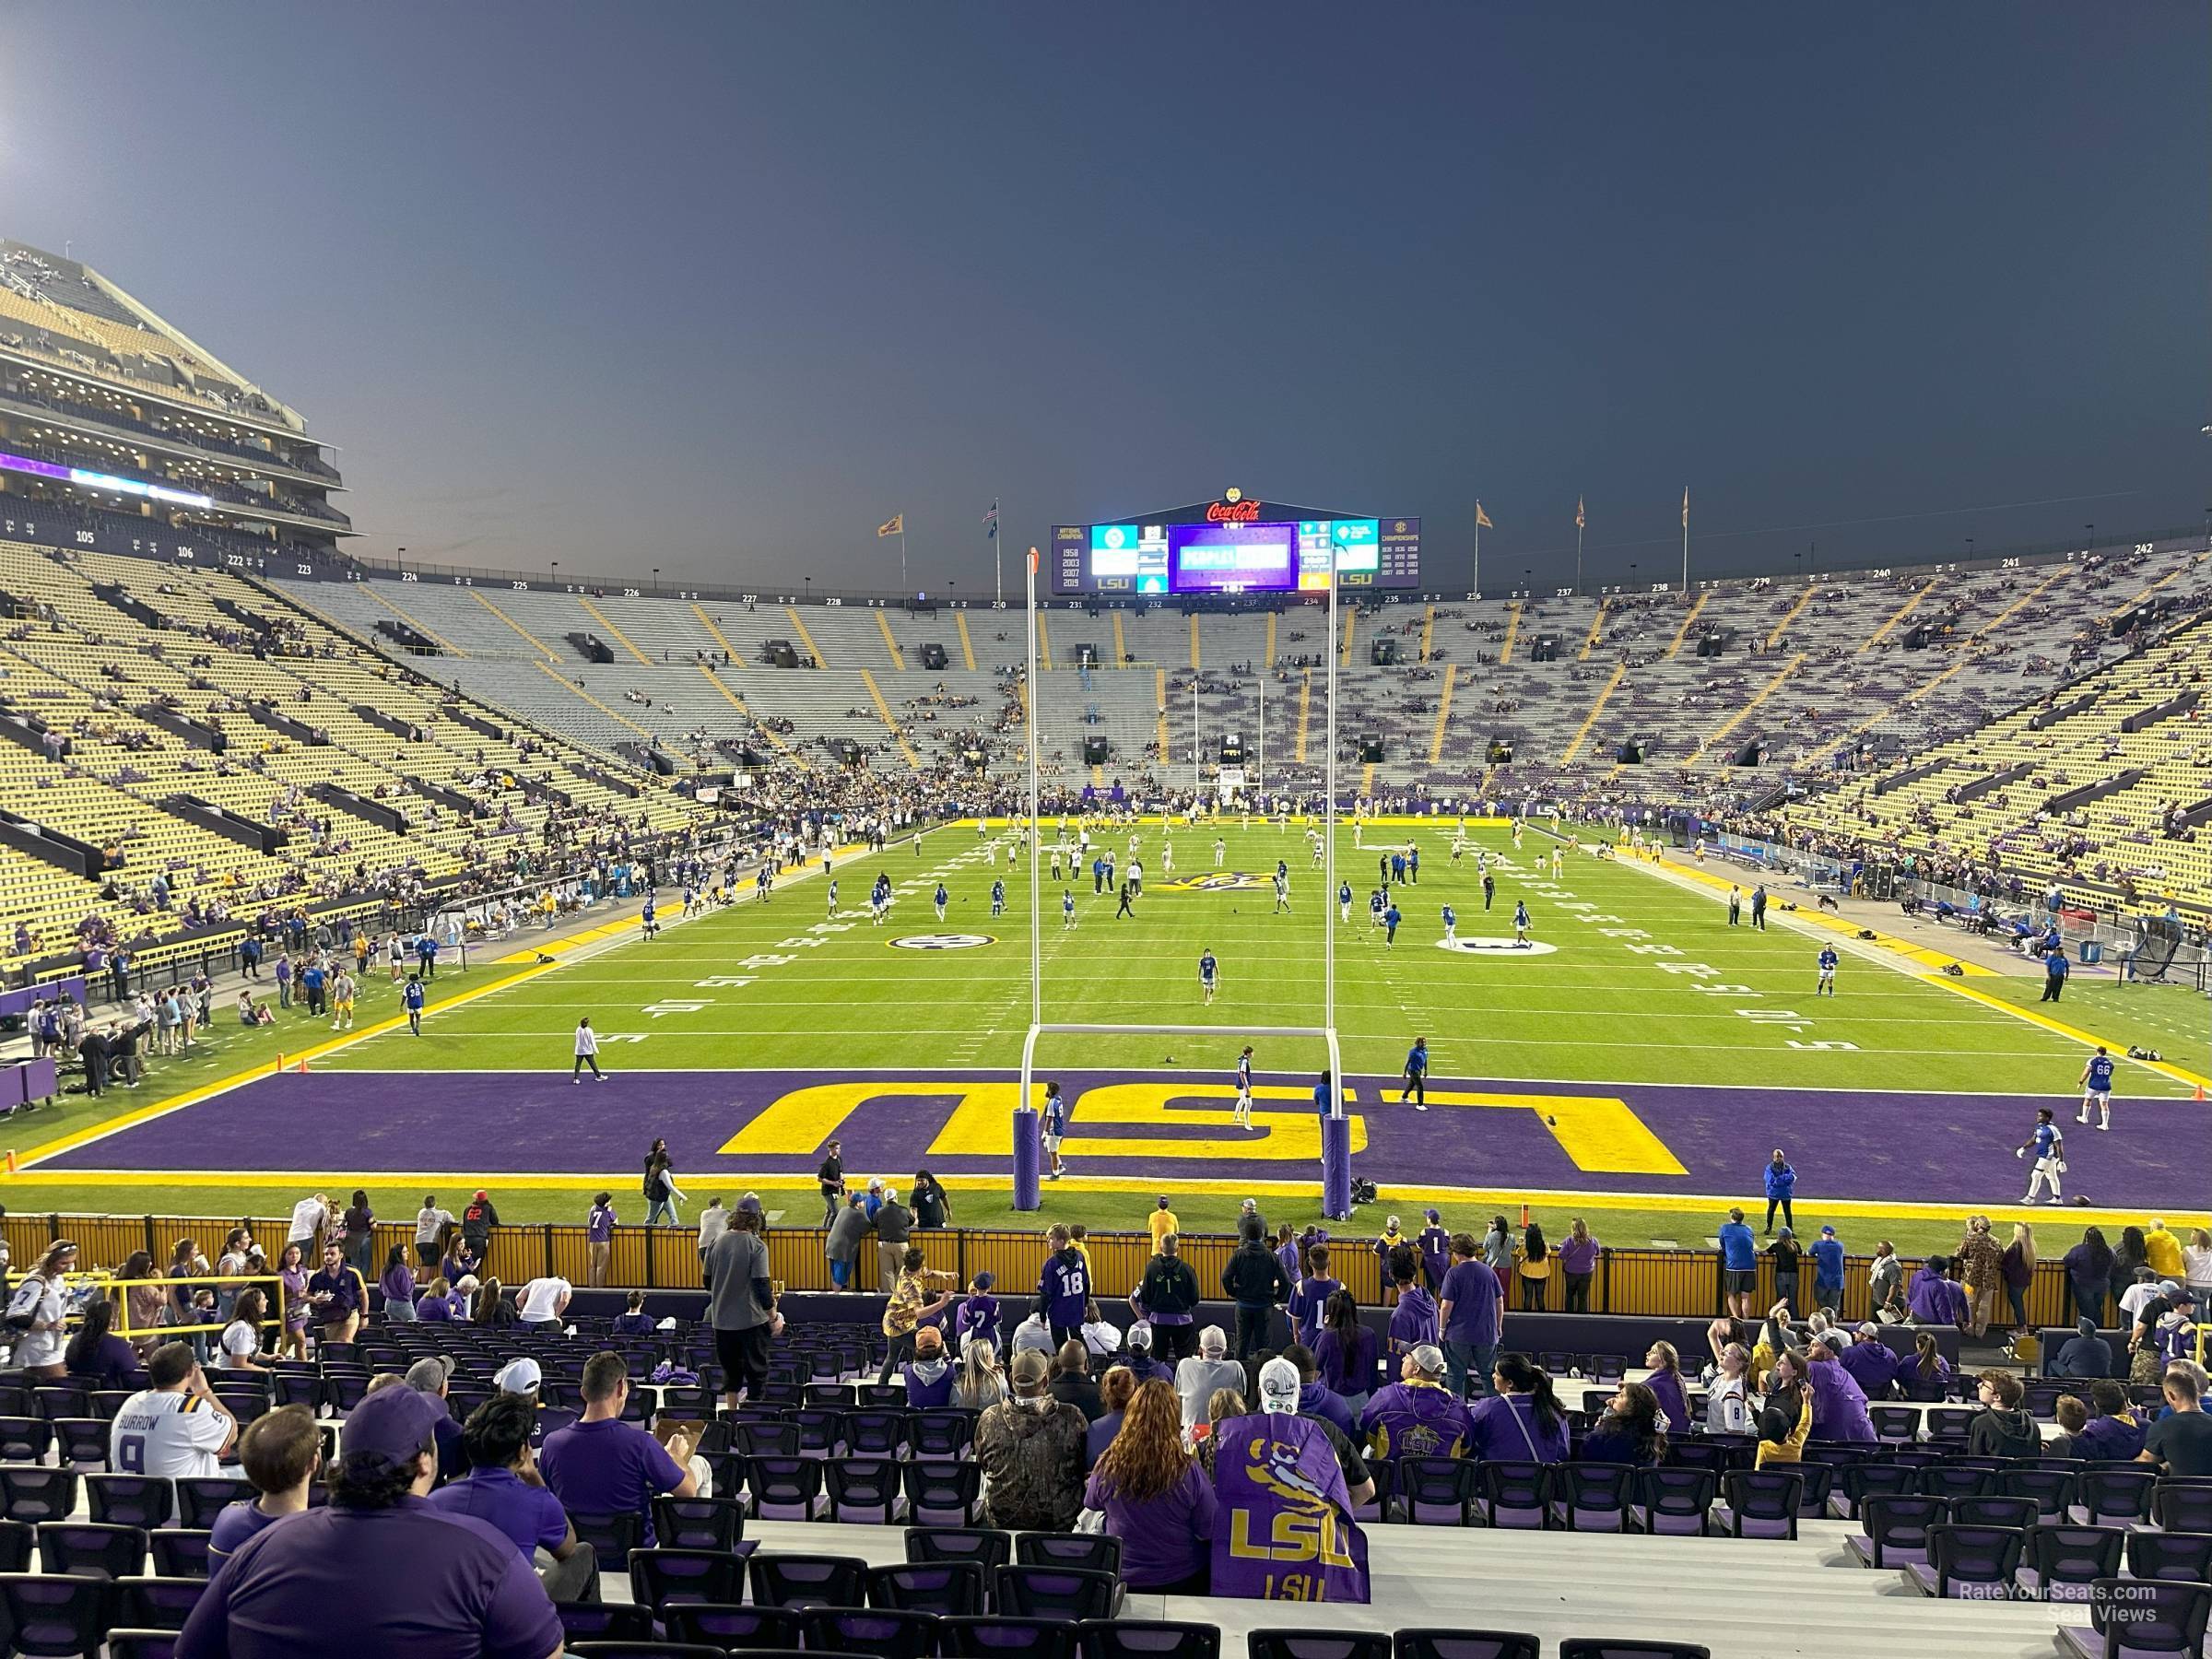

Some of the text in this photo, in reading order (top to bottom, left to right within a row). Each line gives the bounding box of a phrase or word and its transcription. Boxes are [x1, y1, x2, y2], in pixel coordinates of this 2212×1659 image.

[1206, 501, 1261, 522] Coca-Cola
[76, 530, 95, 544] 105
[177, 546, 194, 559] 106
[1063, 548, 1079, 558] 1958
[2134, 543, 2153, 554] 242
[228, 554, 244, 567] 222
[1062, 559, 1080, 568] 2003
[2001, 557, 2020, 568] 241
[297, 563, 312, 575] 223
[1062, 569, 1080, 578] 2007
[1872, 568, 1891, 579] 240
[401, 571, 418, 582] 224
[1063, 578, 1079, 587] 2019
[1339, 573, 1372, 585] LSU
[512, 581, 528, 590] 225
[1097, 578, 1129, 590] LSU
[1652, 583, 1668, 593] 238
[623, 588, 640, 597] 226
[1557, 588, 1573, 596] 237
[742, 594, 758, 603] 227
[826, 597, 841, 606] 228
[992, 600, 1006, 609] 20
[1148, 600, 1162, 608] 232
[1303, 597, 1319, 606] 234
[1384, 594, 1400, 604] 235
[692, 975, 759, 987] 15
[1689, 982, 1765, 997] 15
[641, 998, 716, 1013] 10
[1734, 1009, 1816, 1026] 10
[1784, 1040, 1861, 1050] 5
[2097, 1064, 2111, 1076] 66
[717, 1082, 1688, 1175] LSU
[466, 1208, 482, 1221] 62
[592, 1211, 603, 1229] 7
[1433, 1236, 1440, 1254] 1
[1062, 1271, 1084, 1298] 18
[974, 1310, 986, 1329] 7
[2166, 1333, 2175, 1358] 1
[118, 1415, 160, 1431] BURROW
[119, 1434, 146, 1476] 9
[1230, 1508, 1356, 1568] LSU
